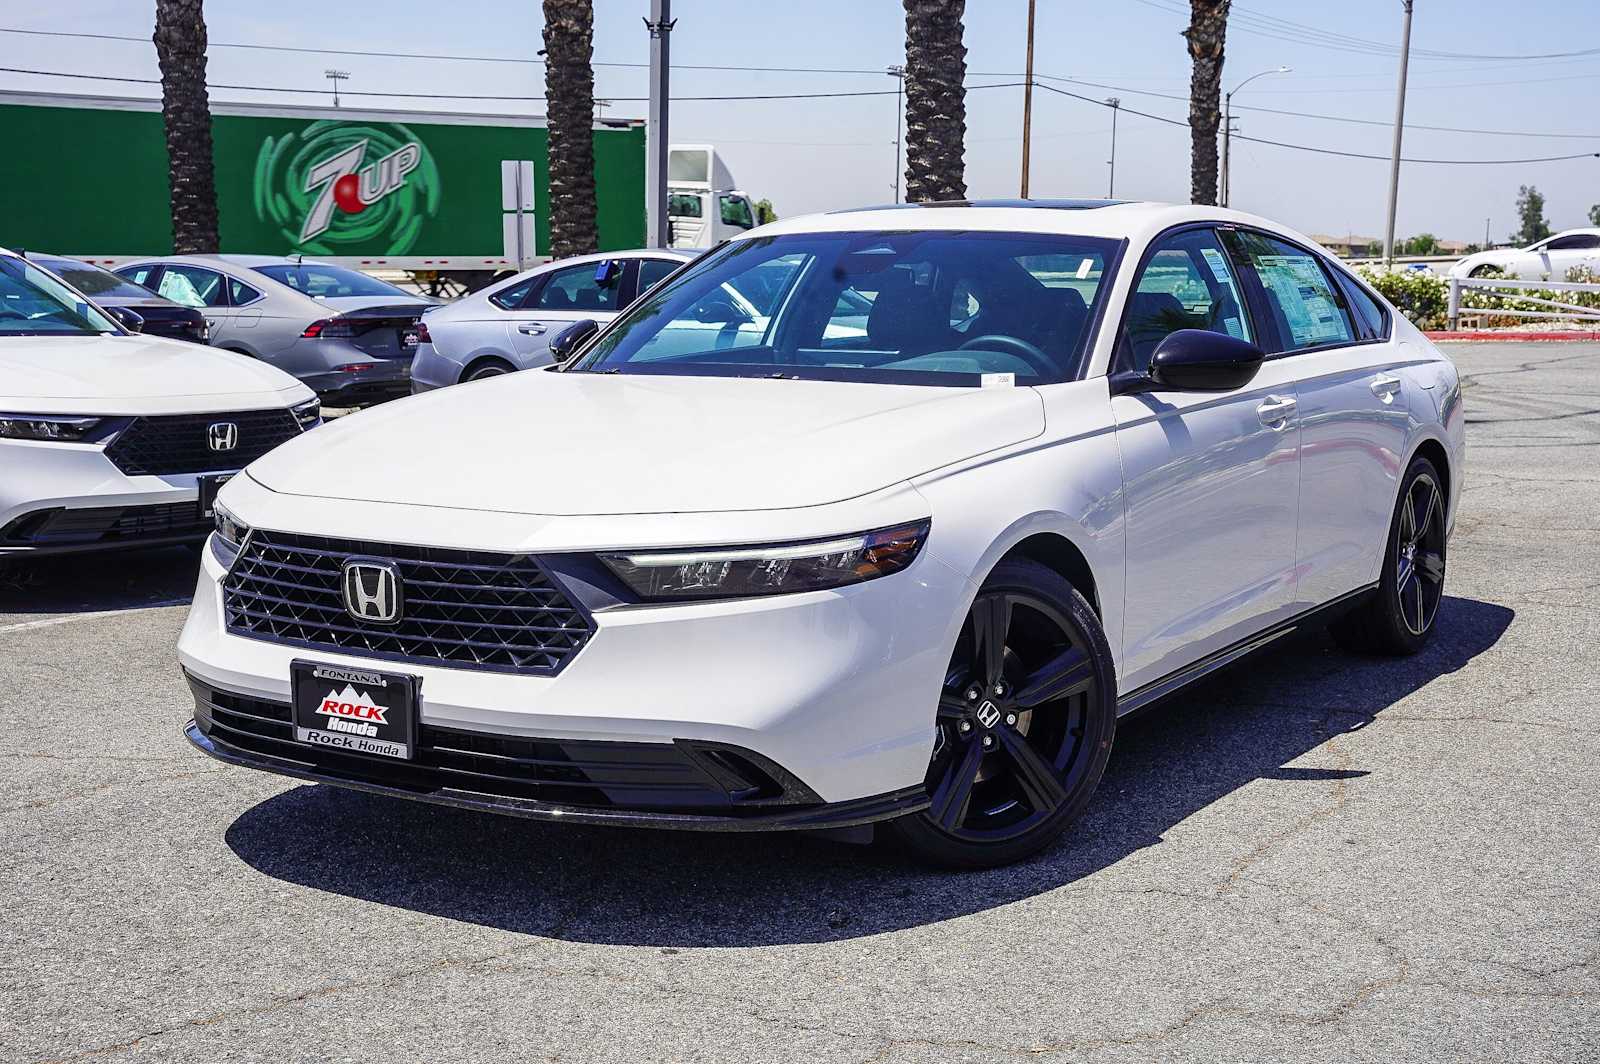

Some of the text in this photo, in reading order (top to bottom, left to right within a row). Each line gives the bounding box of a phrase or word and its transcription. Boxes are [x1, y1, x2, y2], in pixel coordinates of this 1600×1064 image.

[320, 669, 380, 685] FONTANA
[322, 700, 383, 721] ROCK
[327, 717, 379, 738] Honda
[307, 731, 400, 757] Rock Honda
